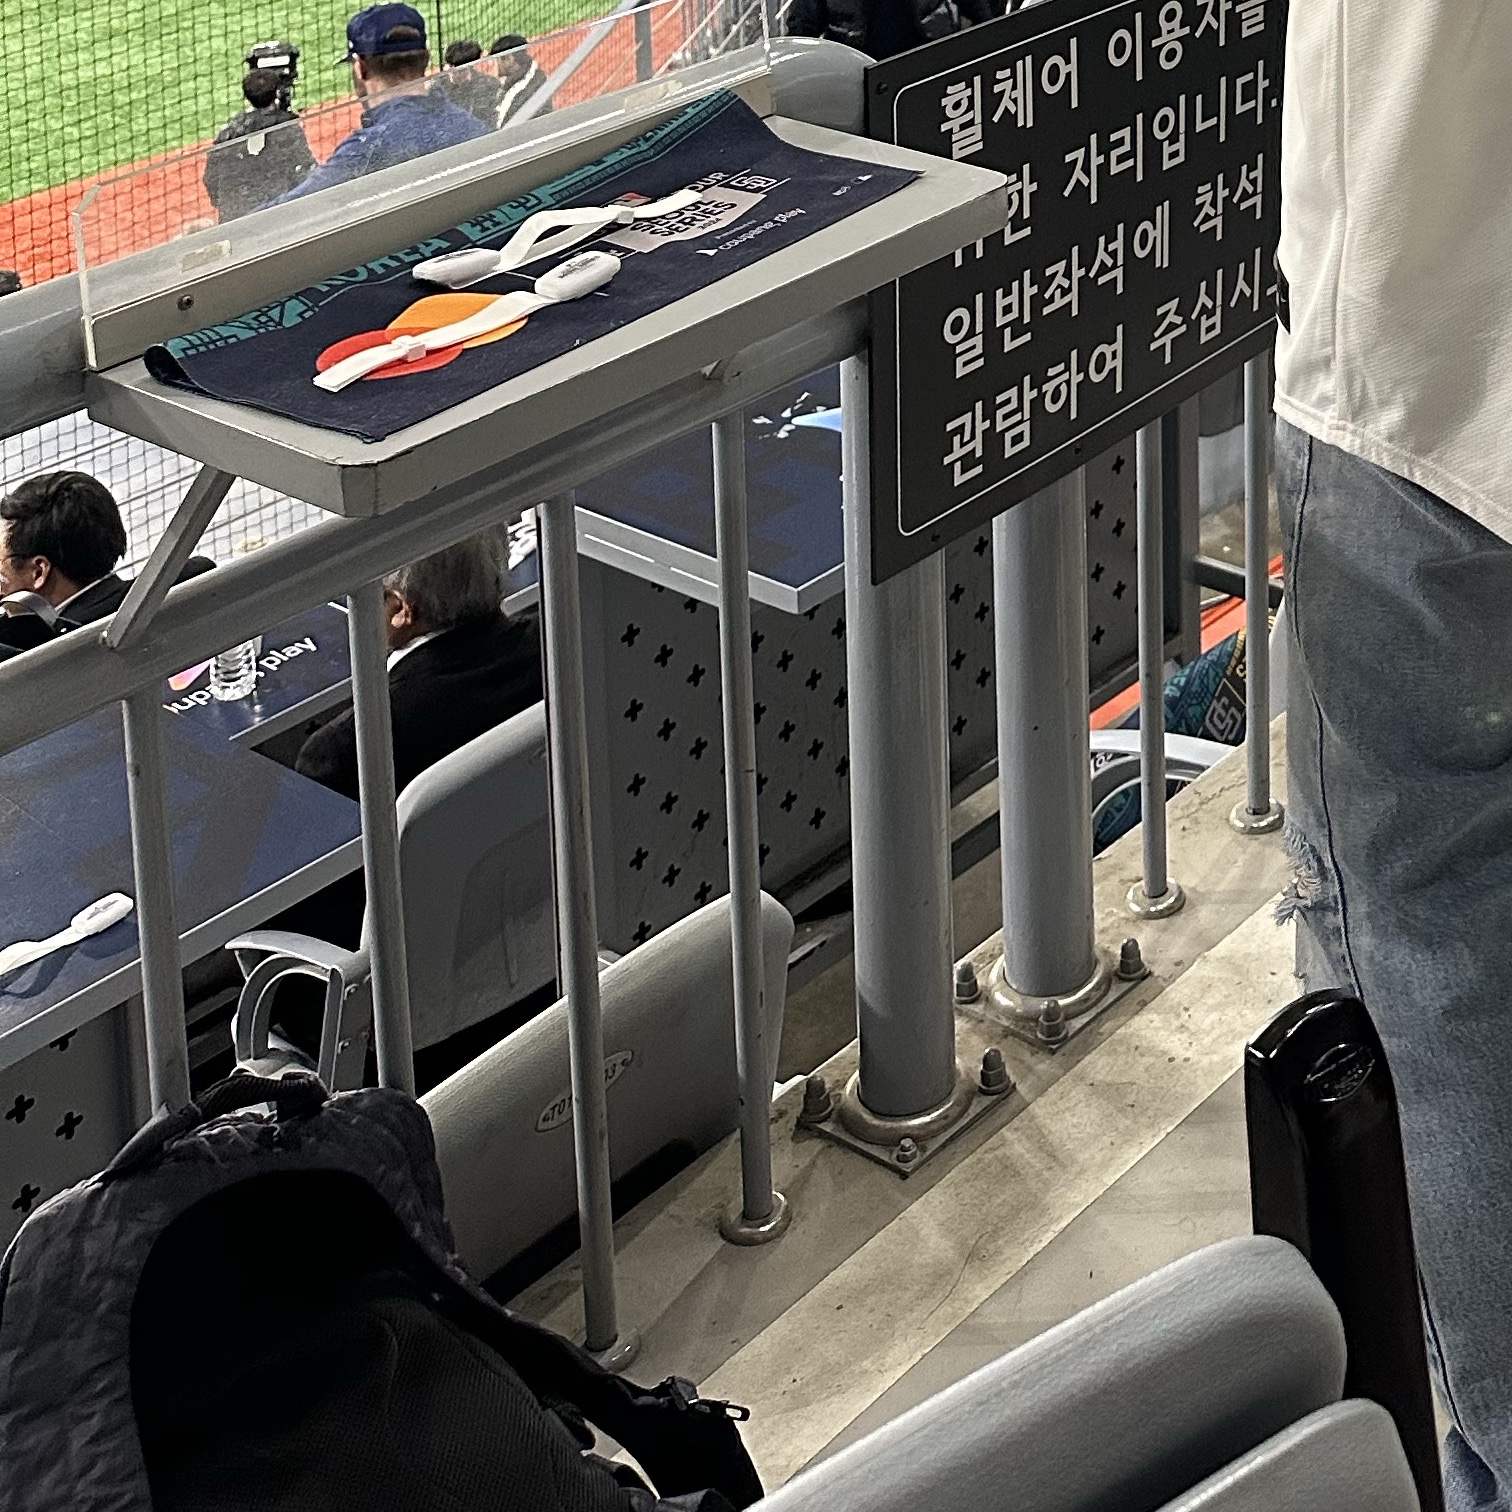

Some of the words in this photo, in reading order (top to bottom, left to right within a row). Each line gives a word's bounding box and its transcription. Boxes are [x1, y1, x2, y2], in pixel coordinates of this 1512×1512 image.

[939, 37, 1079, 160] 휠체어
[1062, 59, 1278, 203] 자리입니다.
[650, 201, 738, 237] SERIES
[684, 172, 730, 192] OUR
[943, 200, 1172, 380] 일반좌석에
[1192, 153, 1266, 241] 착석
[942, 324, 1126, 488] 관람하여
[259, 637, 318, 672] play
